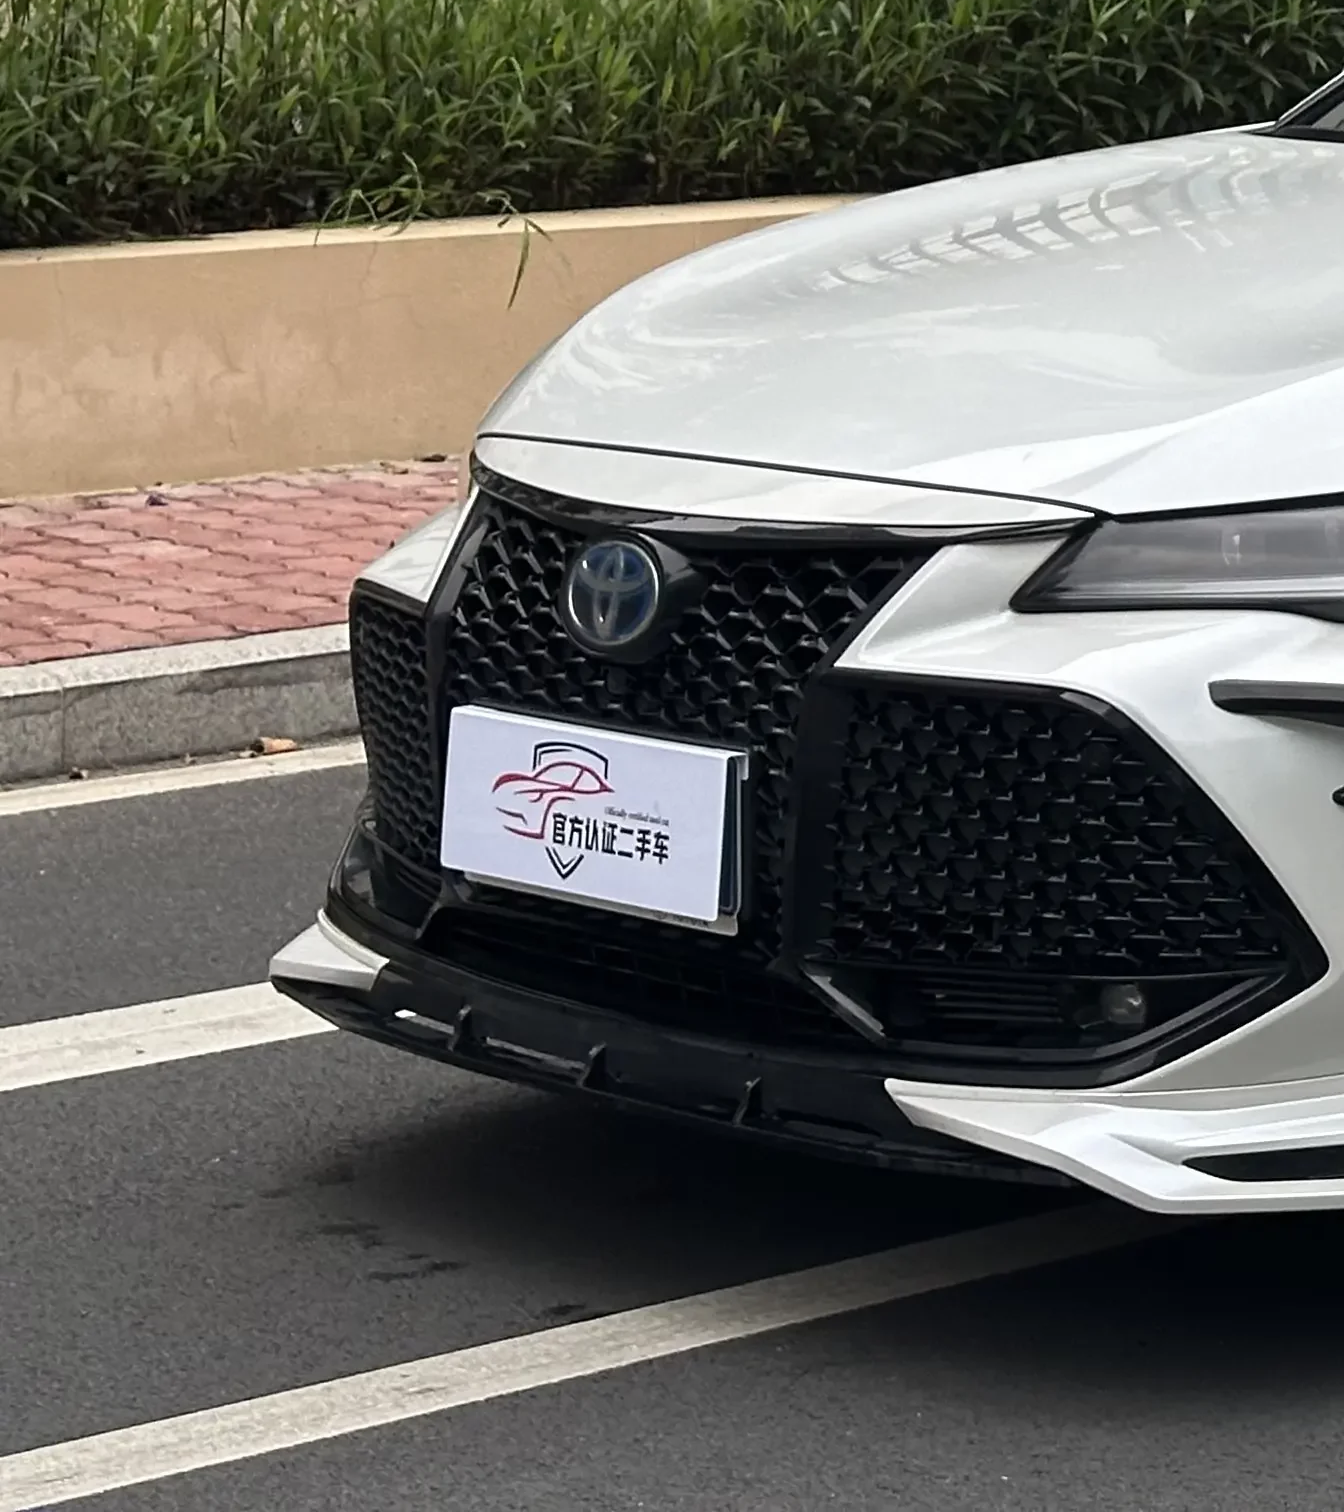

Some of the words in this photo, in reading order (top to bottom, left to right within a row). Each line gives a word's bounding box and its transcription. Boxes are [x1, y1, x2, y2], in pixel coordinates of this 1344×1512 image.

[551, 812, 671, 865] 官方认证二手车
